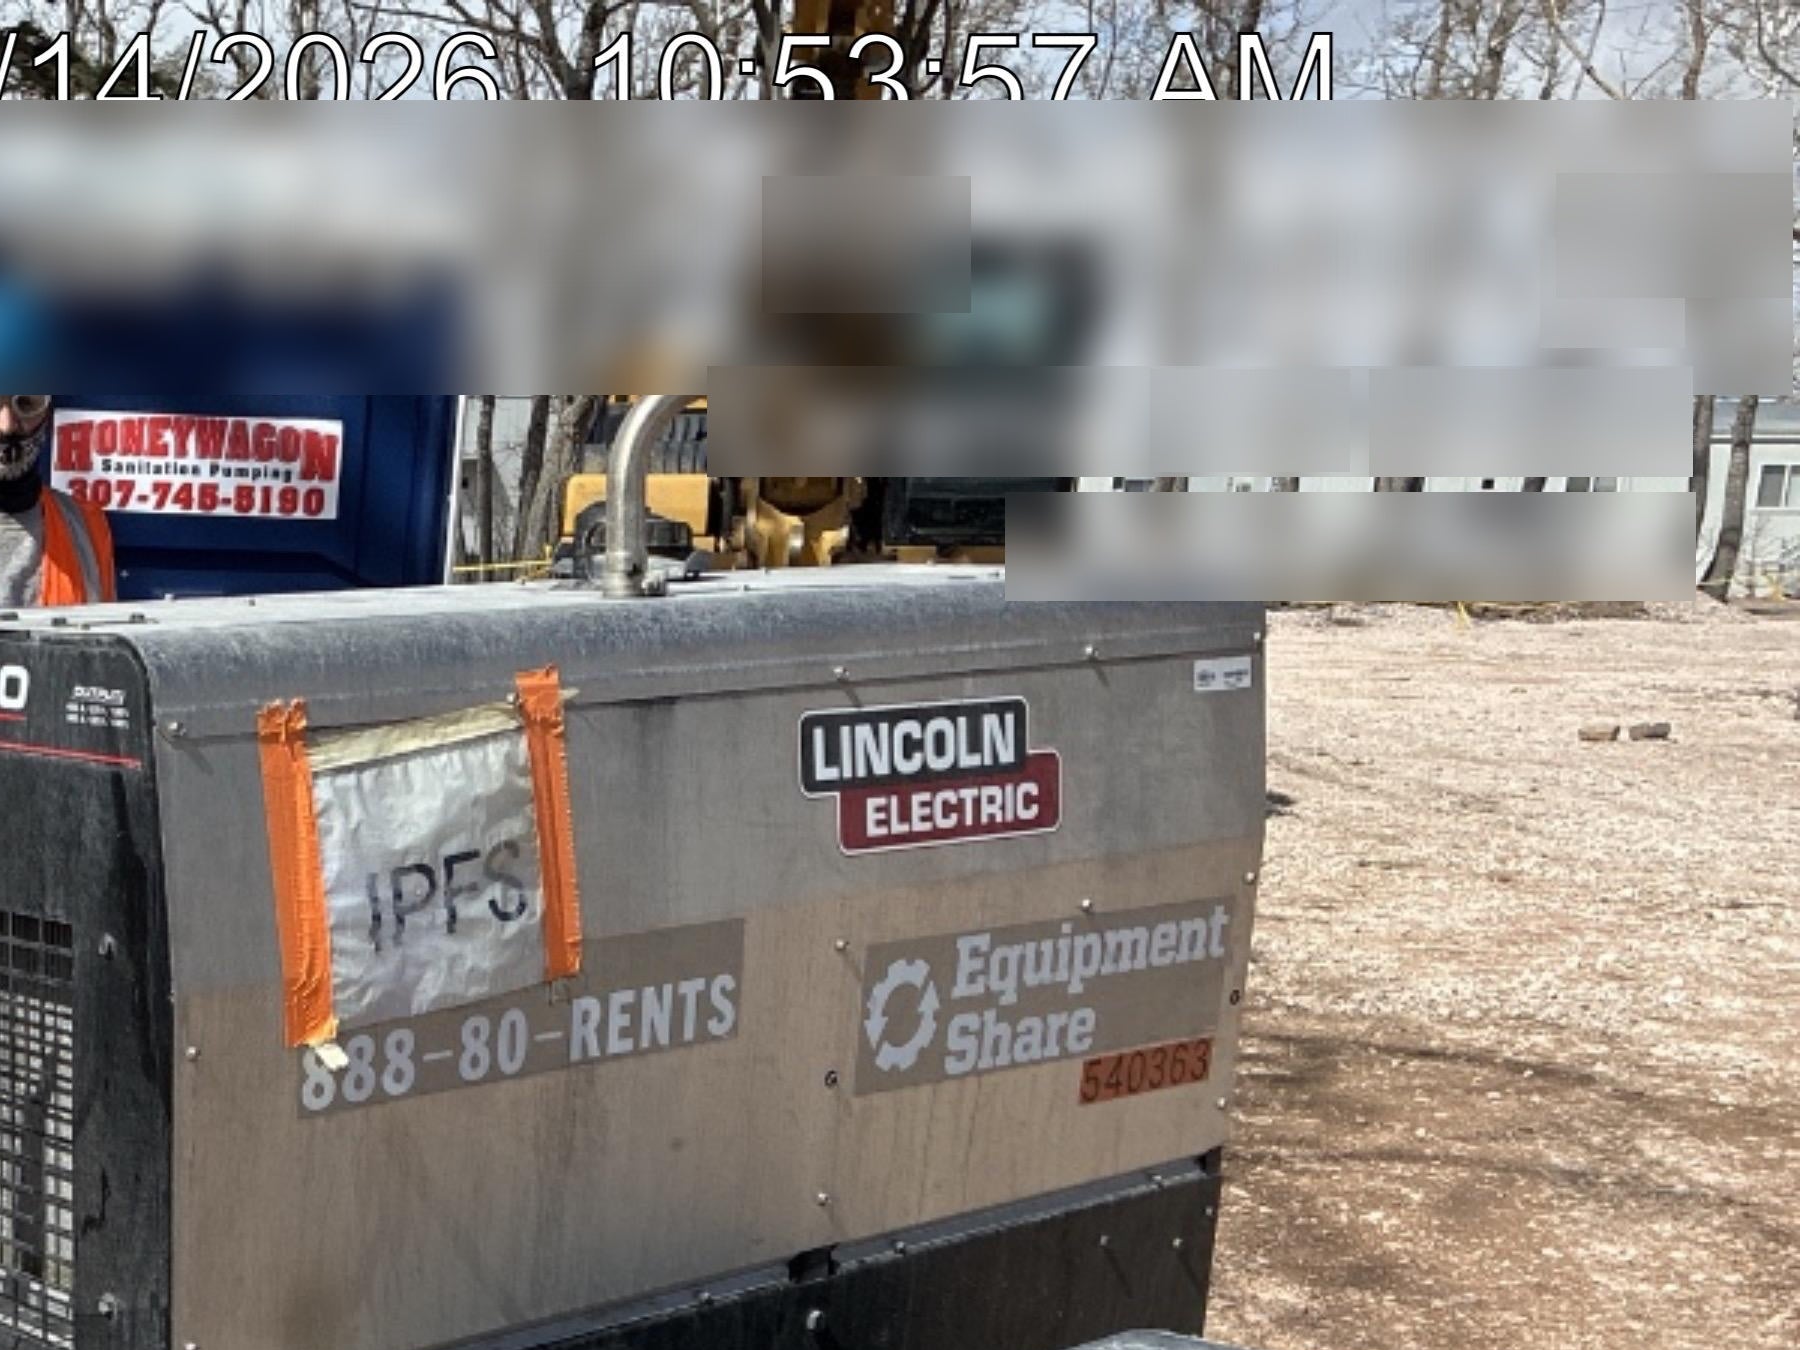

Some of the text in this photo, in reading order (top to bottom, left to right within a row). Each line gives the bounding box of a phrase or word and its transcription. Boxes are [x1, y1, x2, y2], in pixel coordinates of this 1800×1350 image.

[55, 417, 338, 481] HONEYWAGON
[101, 459, 293, 483] Sanitation Pumping
[812, 711, 1017, 782] LINCOLN
[865, 781, 1040, 837] ELECTRIC
[365, 839, 528, 951] IPFS
[951, 905, 1229, 1005] Equipment
[943, 1006, 1096, 1075] Share
[1080, 1039, 1211, 1101] 540363
